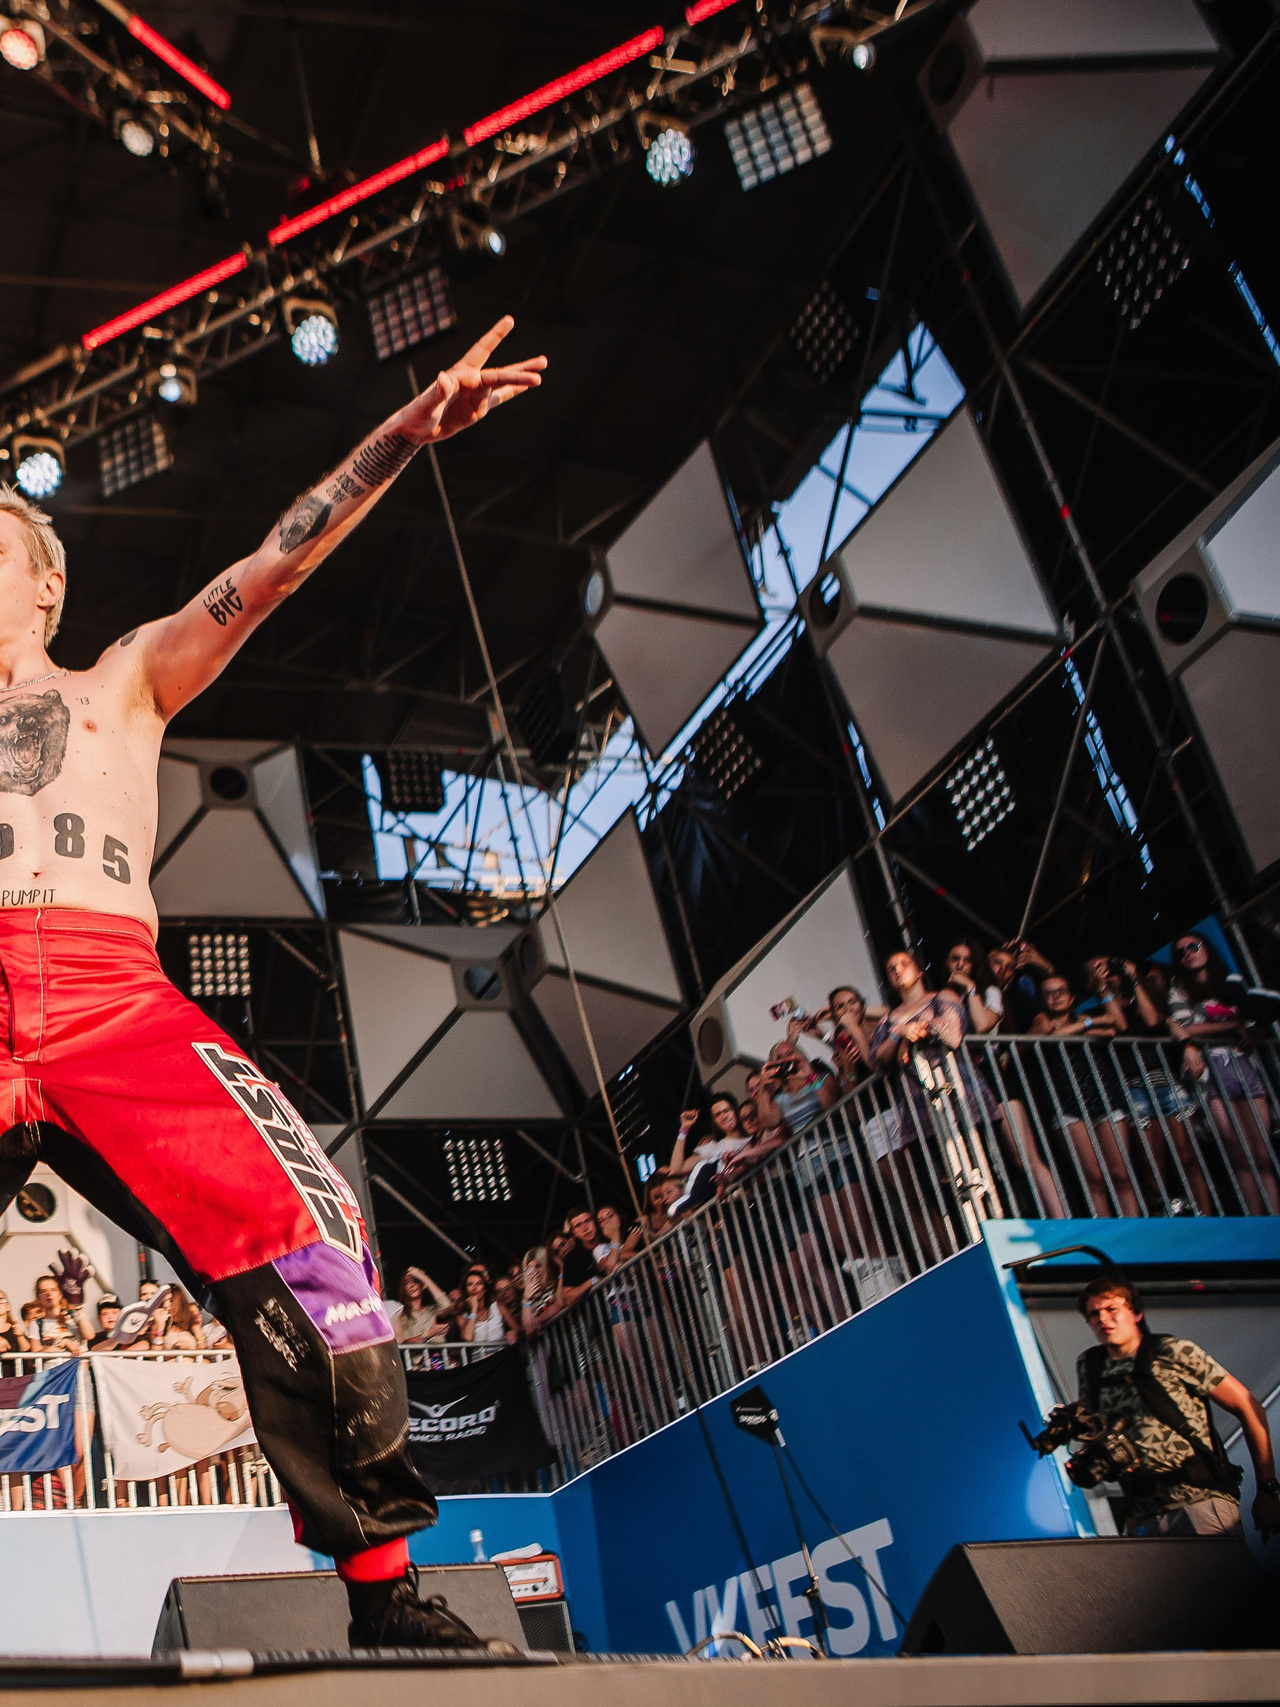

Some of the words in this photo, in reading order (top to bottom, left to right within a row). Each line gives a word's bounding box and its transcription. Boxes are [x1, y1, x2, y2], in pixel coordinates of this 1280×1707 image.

[203, 577, 233, 608] LITTLE
[208, 586, 243, 626] BIG
[198, 1046, 358, 1258] FIRST
[409, 1405, 497, 1433] ECORD
[665, 1517, 898, 1658] VKFEST
